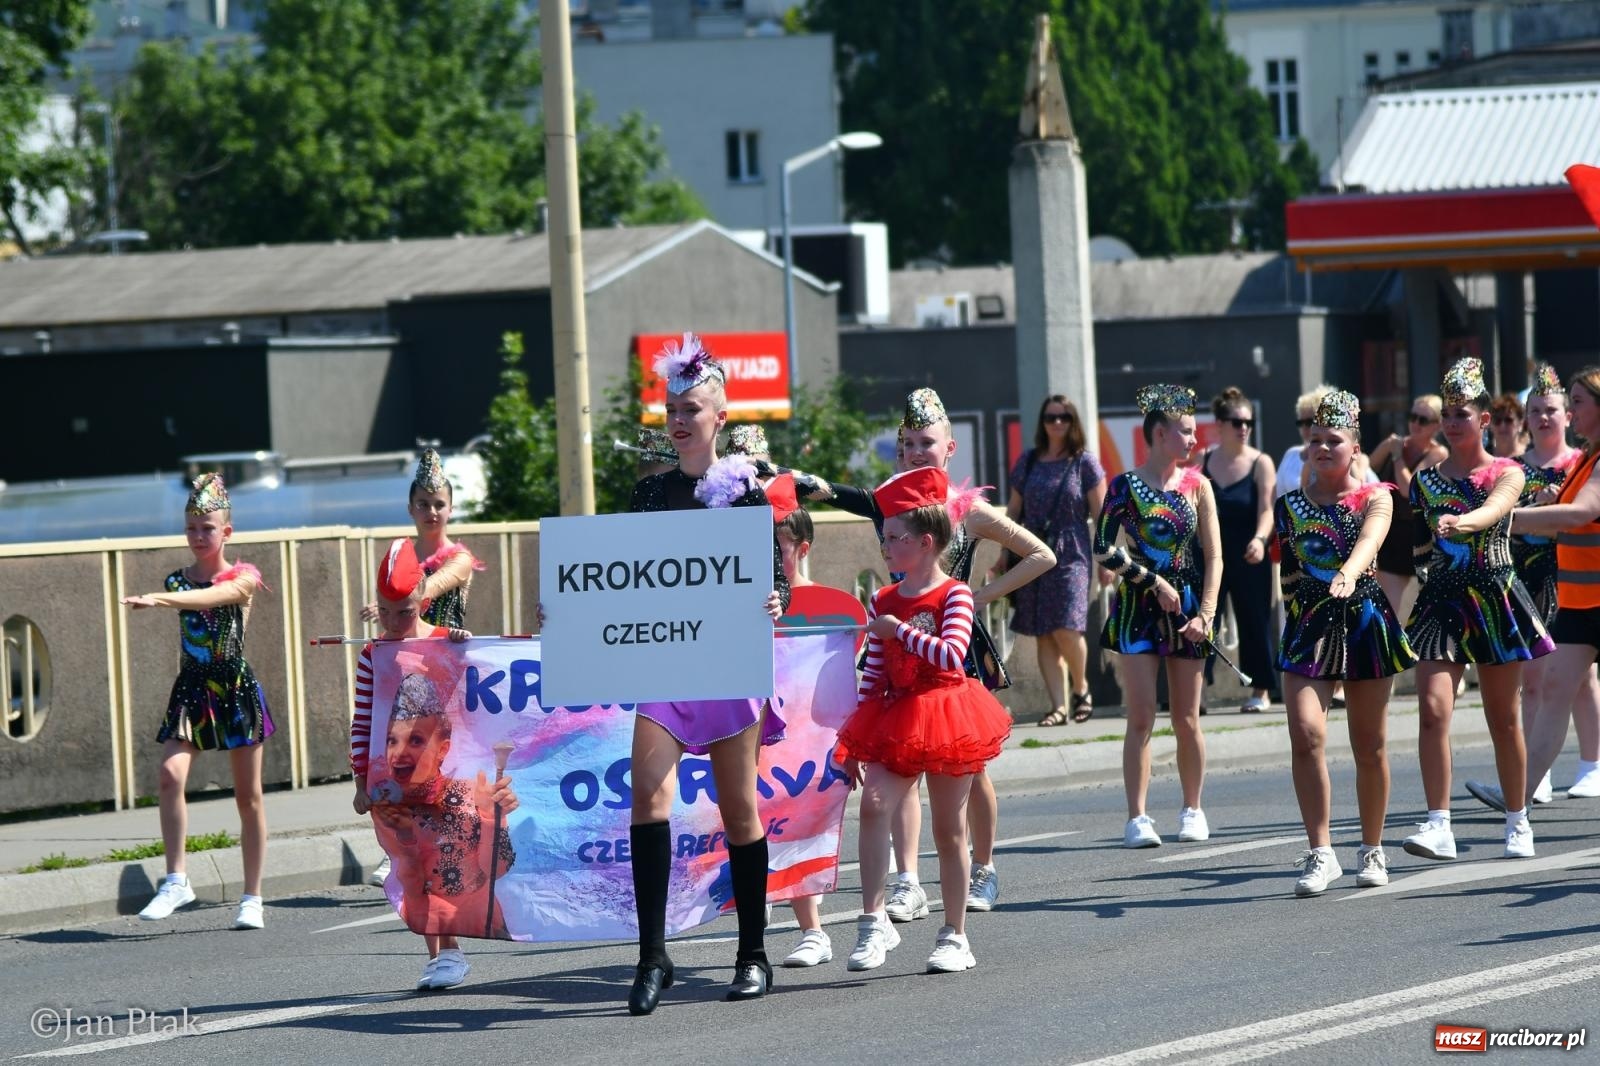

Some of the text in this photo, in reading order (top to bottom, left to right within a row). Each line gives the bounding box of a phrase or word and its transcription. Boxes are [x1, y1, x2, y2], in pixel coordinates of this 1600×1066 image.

[558, 556, 753, 593] KROKODYL
[602, 620, 703, 645] CZECHY
[577, 838, 634, 864] CZE
